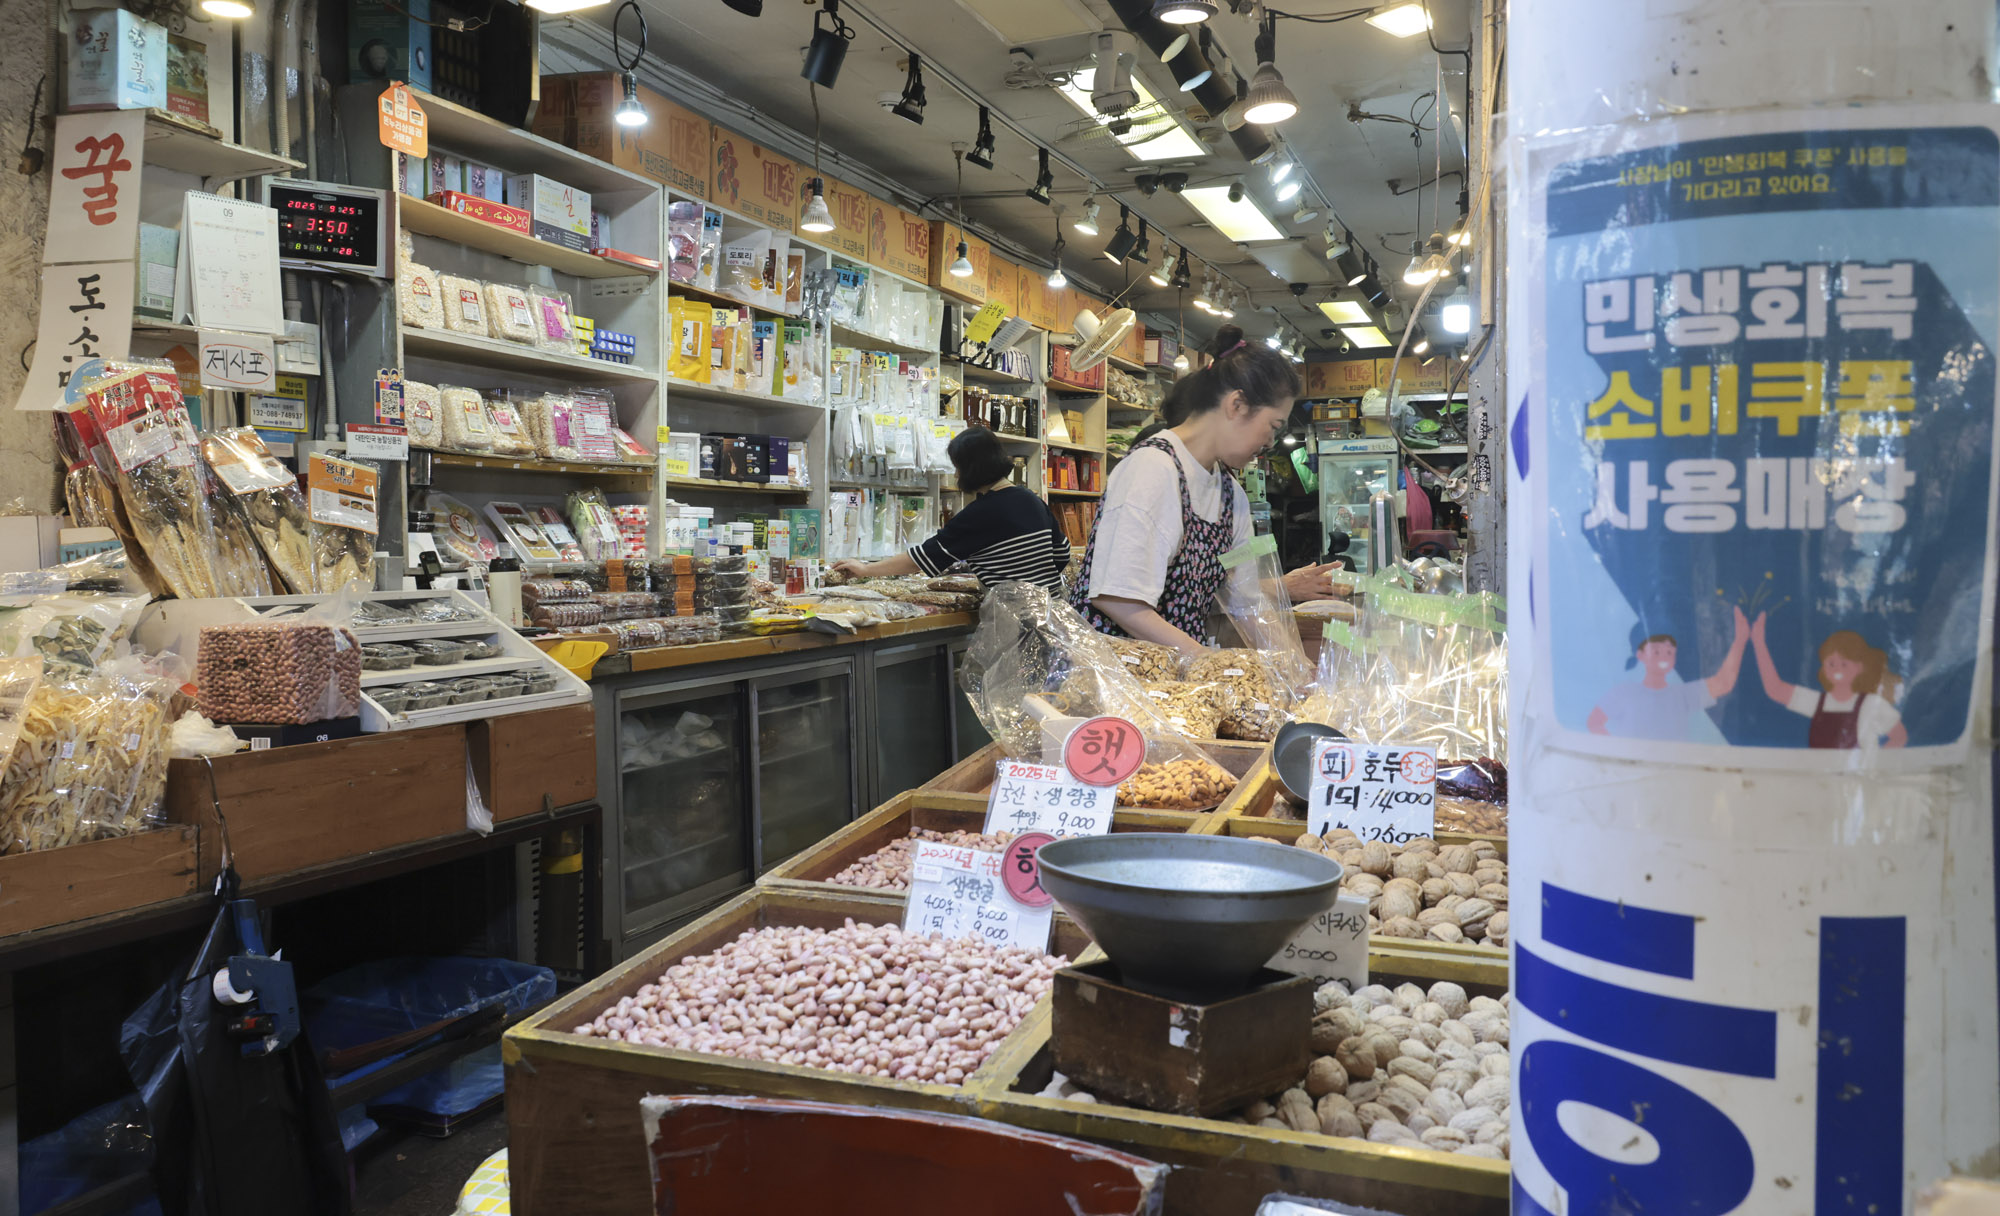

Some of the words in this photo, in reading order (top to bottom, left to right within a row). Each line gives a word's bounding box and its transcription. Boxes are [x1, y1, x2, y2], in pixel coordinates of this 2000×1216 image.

[61, 133, 132, 226] 꿀
[763, 160, 795, 207] 대추
[1682, 177, 1761, 201] 기다리고
[1767, 174, 1838, 195] 있어요.
[223, 208, 233, 217] 09
[288, 200, 316, 210] 2025
[330, 205, 336, 213] 9
[342, 206, 355, 215] 25
[838, 192, 866, 234] 대추
[306, 218, 347, 234] 3:50
[904, 221, 928, 259] 대추
[729, 251, 752, 261] 도토리
[1584, 262, 1917, 355] 민생회복
[204, 348, 269, 379] 제사포
[1344, 362, 1372, 382] 대추
[1584, 360, 1915, 440] 소비쿠폰
[252, 409, 303, 420] 132-088-748937
[355, 434, 376, 443] 대한민국
[326, 462, 355, 479] 용대리
[1584, 457, 1915, 534] 사용매장
[1081, 726, 1126, 777] 햇
[1322, 750, 1346, 780] 피
[1362, 750, 1403, 784] 호두
[1402, 756, 1434, 778] 국산
[1000, 781, 1026, 806] 국산
[1058, 811, 1096, 830] 9.000
[976, 905, 1008, 921] 5.000
[973, 920, 1009, 940] 9.000
